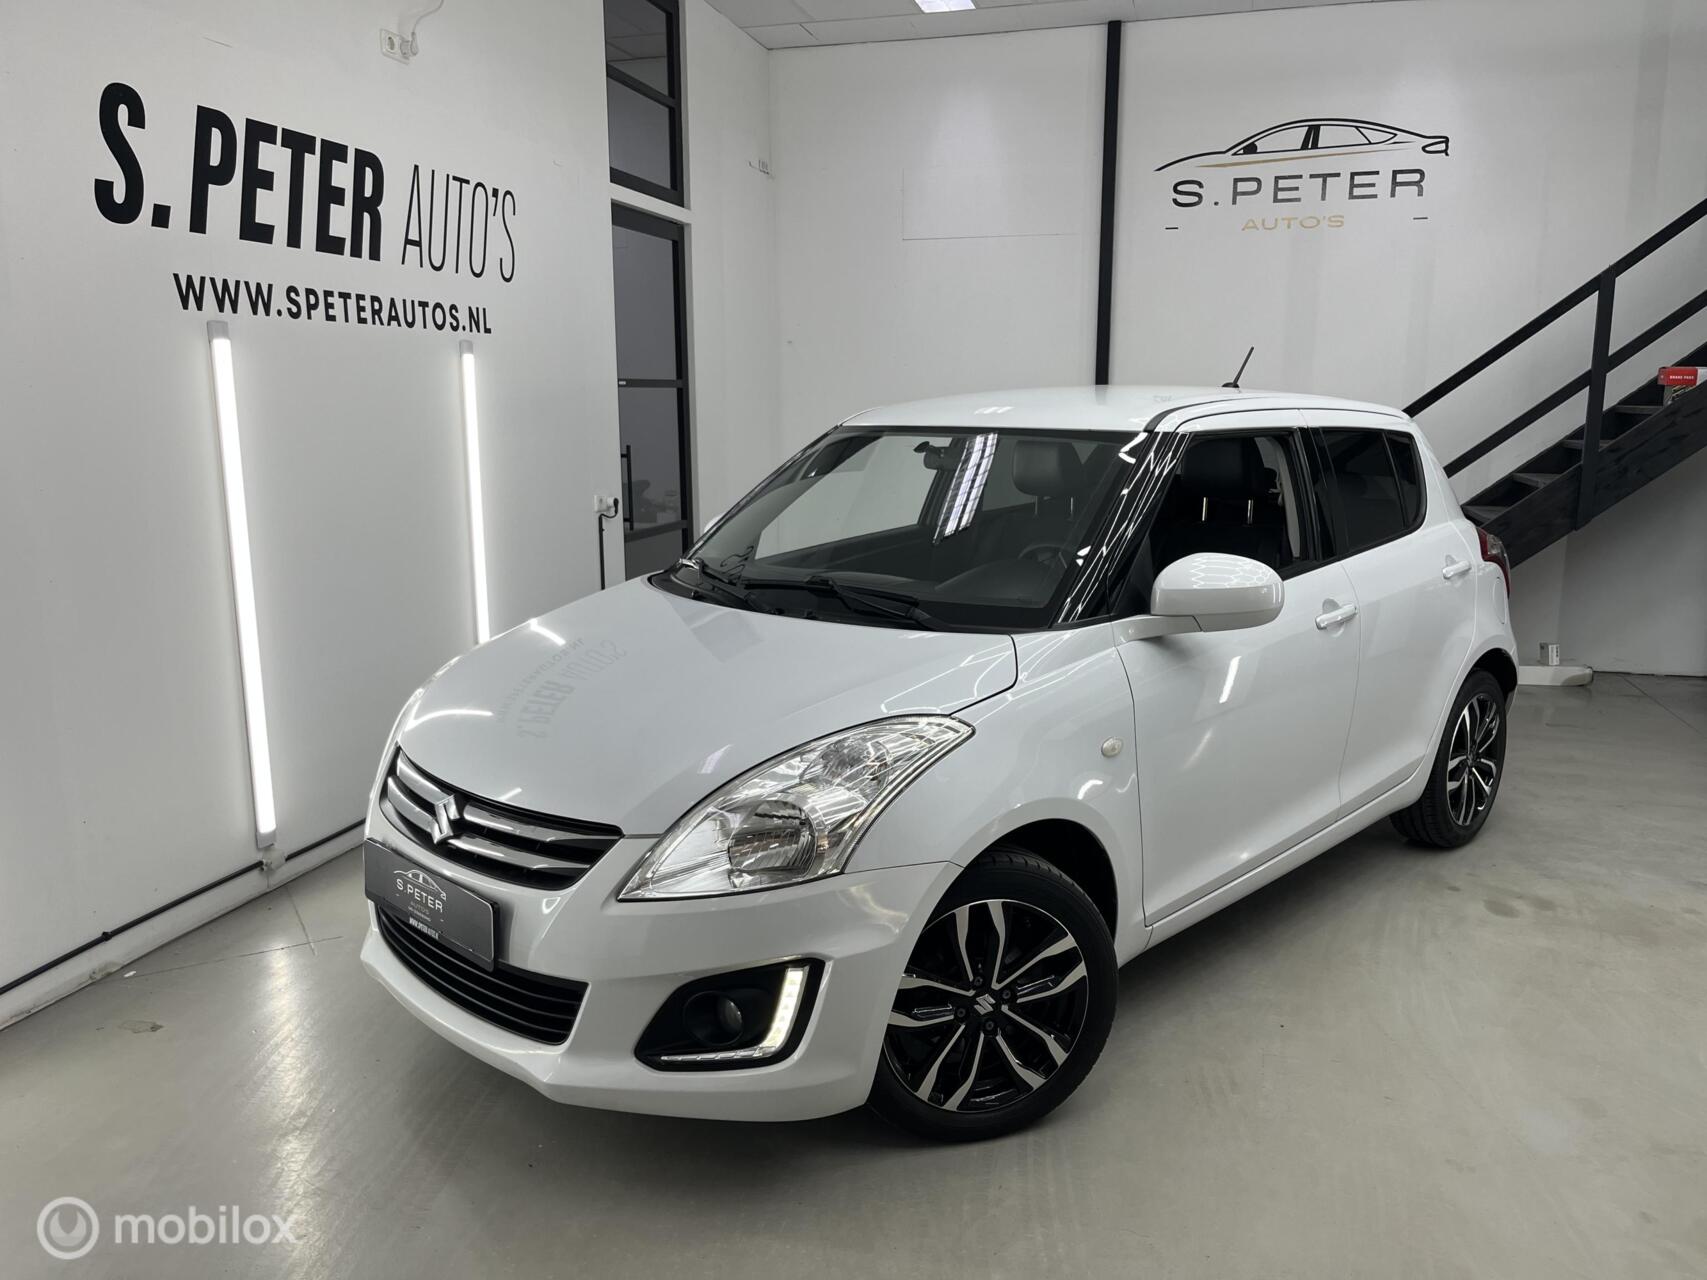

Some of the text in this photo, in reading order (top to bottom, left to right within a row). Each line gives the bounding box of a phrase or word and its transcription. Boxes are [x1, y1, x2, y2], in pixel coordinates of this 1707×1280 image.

[401, 164, 517, 283] AUTO'S
[1241, 215, 1345, 231] AUTO'S
[172, 272, 493, 334] WWW.SPETERAUTOS.NL
